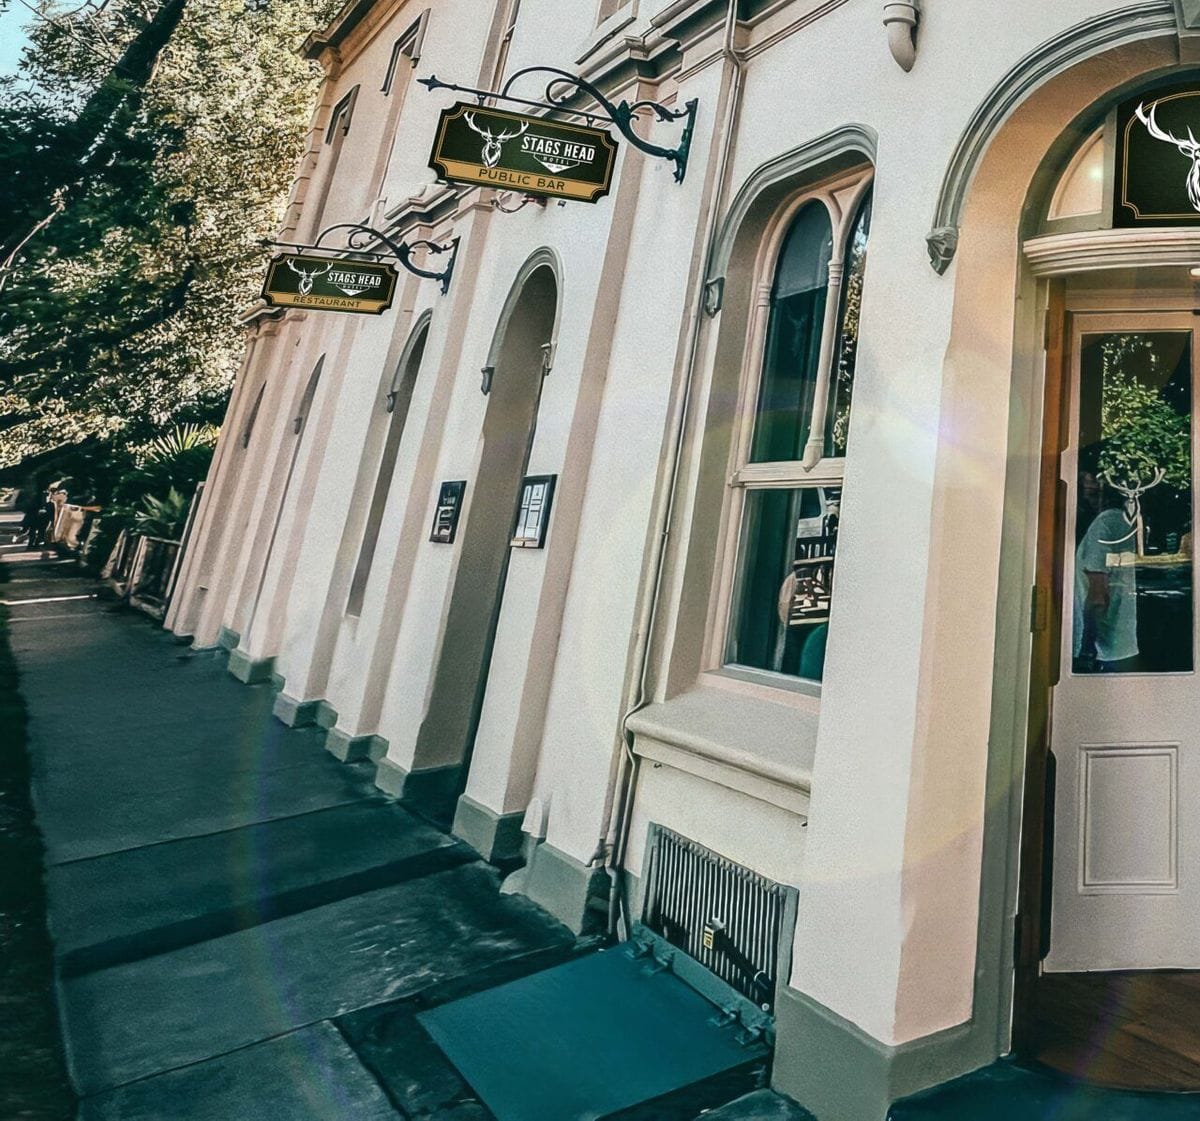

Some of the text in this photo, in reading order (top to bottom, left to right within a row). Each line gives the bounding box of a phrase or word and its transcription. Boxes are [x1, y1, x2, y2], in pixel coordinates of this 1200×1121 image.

[521, 136, 596, 161] STAGS HEAD
[478, 167, 566, 192] PUBLIC BAR
[327, 272, 382, 286] STAGS HEAD
[293, 295, 362, 309] RESTAURANT
